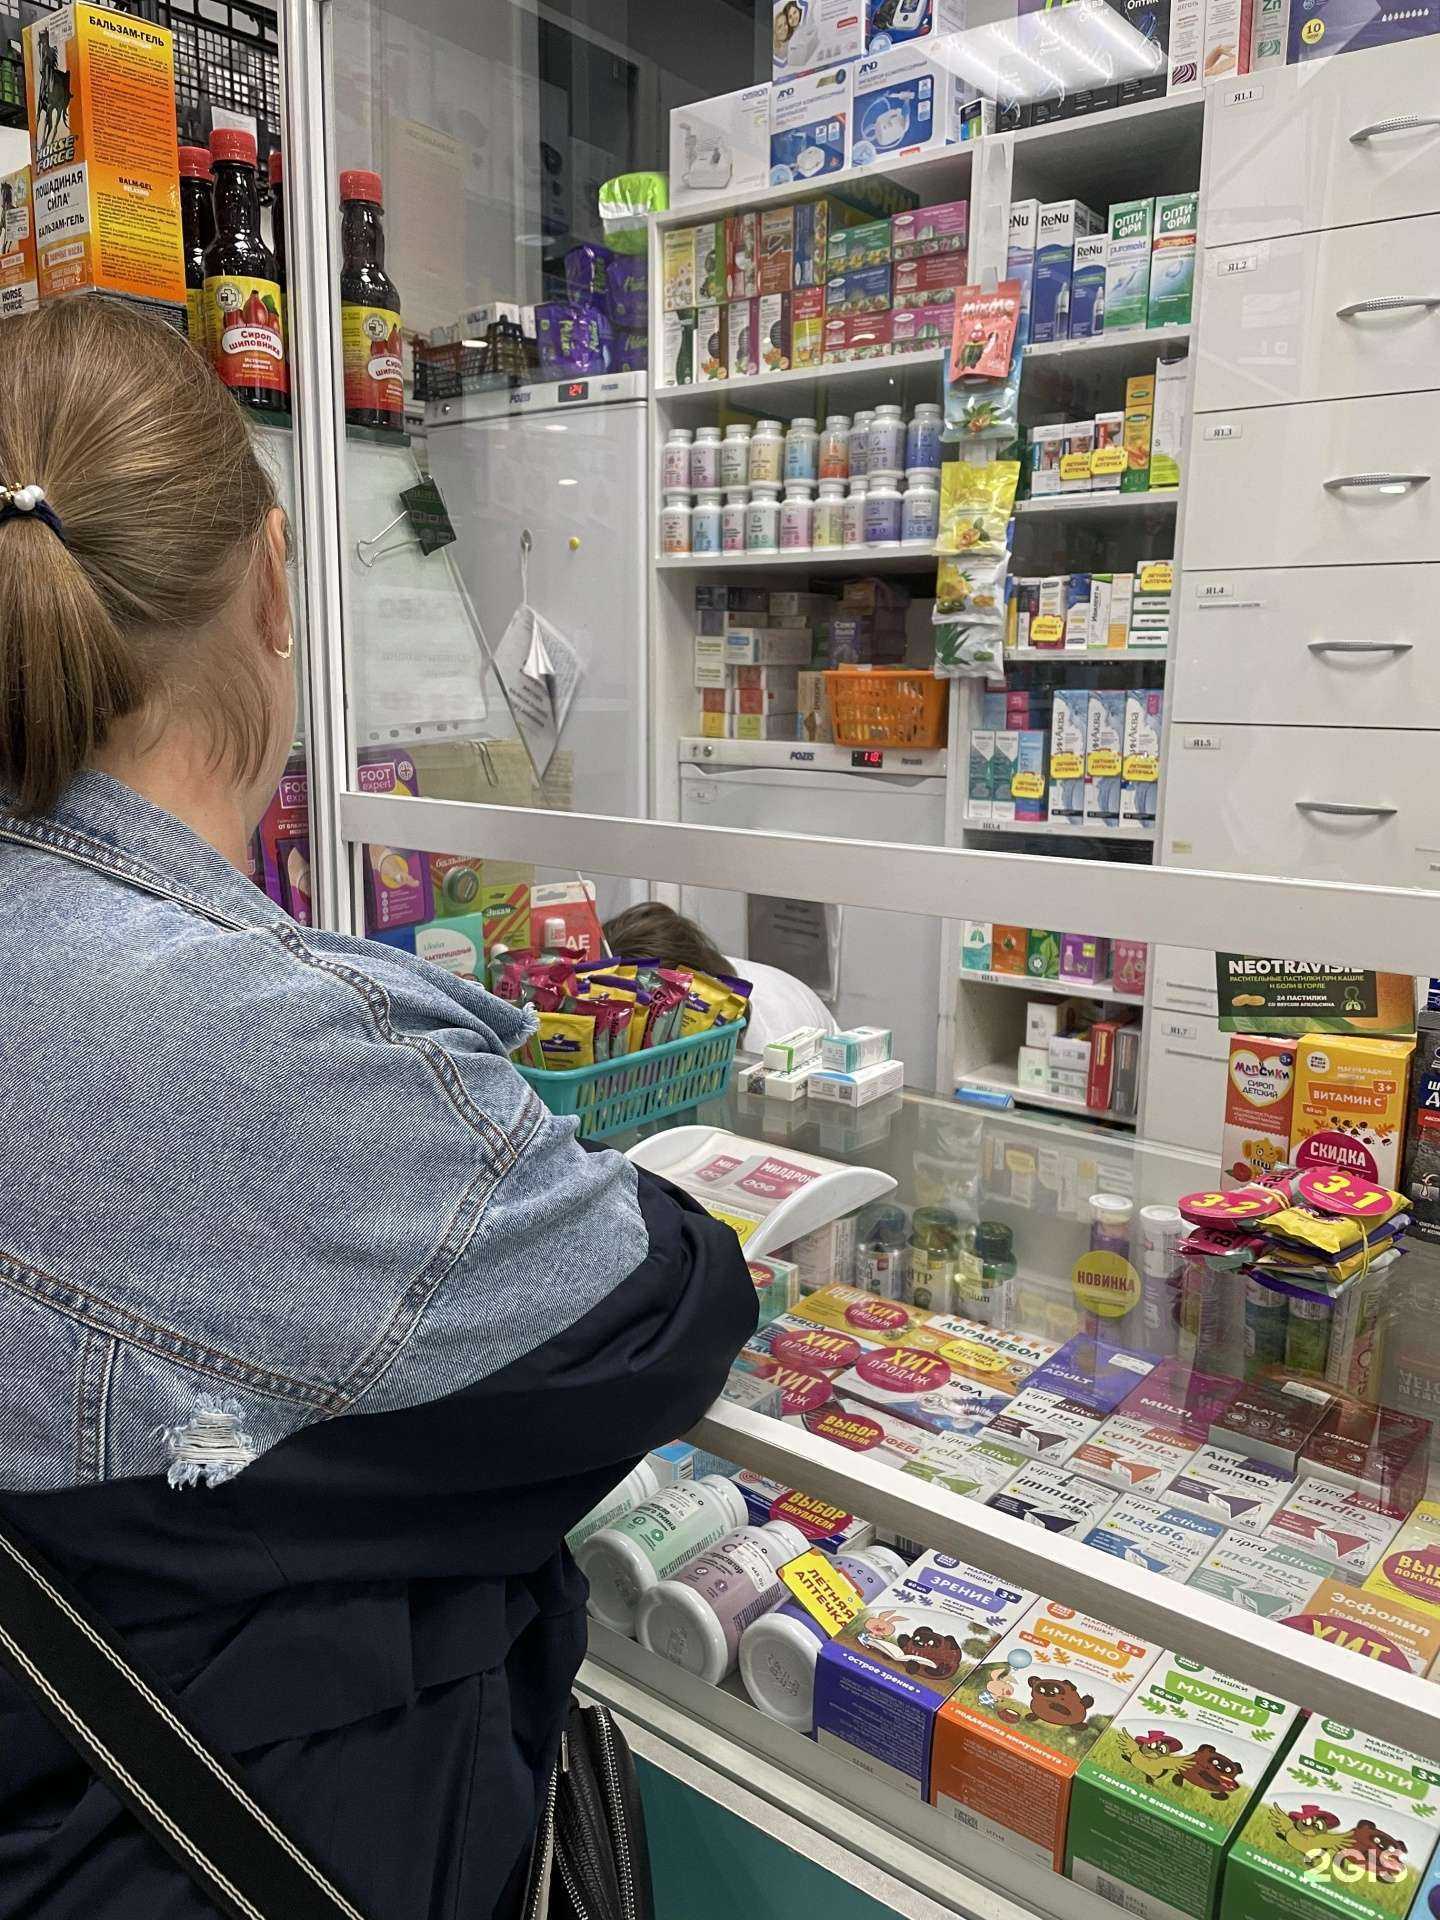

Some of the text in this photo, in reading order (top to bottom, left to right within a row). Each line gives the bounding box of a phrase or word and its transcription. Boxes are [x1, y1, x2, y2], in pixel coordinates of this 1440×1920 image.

[88, 15, 165, 47] БАЛЬЗАМ-ГЕЛЬ
[1306, 22, 1322, 35] 10
[36, 135, 76, 159] HORSE
[37, 149, 75, 175] FORCE
[38, 213, 85, 238] БАЛЬЗАМ-ГЕЛЬ
[1009, 213, 1029, 228] eNu
[1041, 212, 1069, 228] ReNu
[1114, 212, 1146, 228] ОПТИ-
[1162, 206, 1196, 221] ОПТИ-
[1166, 214, 1191, 230] ФРИ
[1119, 223, 1142, 237] ФРИ
[1077, 244, 1103, 258] ReNu
[228, 335, 281, 357] шиповника
[240, 329, 273, 342] Сироп
[360, 768, 392, 782] FOOT
[362, 778, 394, 792] expert
[1242, 1085, 1279, 1099] ДЕТСКИЙ
[1247, 1079, 1274, 1089] СИРОП
[1376, 1080, 1394, 1093] 3+
[1313, 1091, 1372, 1107] ВИТАМИН
[1310, 1141, 1366, 1167] СКИДКА
[1077, 1269, 1135, 1294] НОВИНКА
[850, 1308, 893, 1328] ПРОДАЖ
[861, 1302, 901, 1320] ХИТ
[780, 1339, 841, 1362] ПРОДАЖ
[798, 1331, 853, 1351] ХИТ
[940, 1321, 1041, 1361] ЛОРАНЕБОЛ
[867, 1359, 932, 1386] ПРОДАЖ
[883, 1348, 944, 1375] ХИТ
[763, 1366, 823, 1394] ХИТ
[1042, 1366, 1094, 1385] ADULT
[1015, 1400, 1086, 1429] ven pro
[1024, 1391, 1096, 1419] vipro active
[1234, 1400, 1288, 1420] FOLATE
[816, 1423, 871, 1446] ПОКУПАТЕЛЯ
[822, 1415, 881, 1439] ВЫБОР
[1112, 1418, 1188, 1448] vipro active
[940, 1434, 1014, 1463] vipro active
[1322, 1431, 1370, 1449] COPPER
[1028, 1465, 1064, 1481] vipro
[1015, 1475, 1096, 1510] immuni
[1306, 1483, 1397, 1517] vipro active
[779, 1502, 836, 1531] ПОКУПАТЕЛЯ
[787, 1491, 847, 1521] ВЫБОР
[1059, 1500, 1090, 1517] plus
[1123, 1497, 1212, 1534] vipro active
[1297, 1493, 1367, 1522] cardio
[1166, 1539, 1201, 1557] forte
[1227, 1535, 1323, 1573] vipro active
[1215, 1548, 1312, 1587] memory
[794, 1570, 849, 1630] АПТЕЧКА
[806, 1567, 856, 1620] ЛЕТНЯЯ
[930, 1576, 993, 1605] ЗРЕНИЕ
[999, 1590, 1018, 1601] 3+
[1330, 1591, 1432, 1638] Эсфолил
[1040, 1624, 1121, 1662] ИММУНО
[1122, 1643, 1141, 1656] 3+
[847, 1655, 916, 1694] острое зрение
[1176, 1681, 1257, 1719] МУЛЬТИ
[1259, 1699, 1280, 1712] 3+
[1006, 1733, 1063, 1765] иммунитета
[1326, 1749, 1416, 1791] МУЛЬТИ
[1416, 1769, 1439, 1783] 3+
[1096, 1771, 1208, 1830] память и внимание
[1252, 1851, 1298, 1880] память
[1310, 1881, 1378, 1918] внимание
